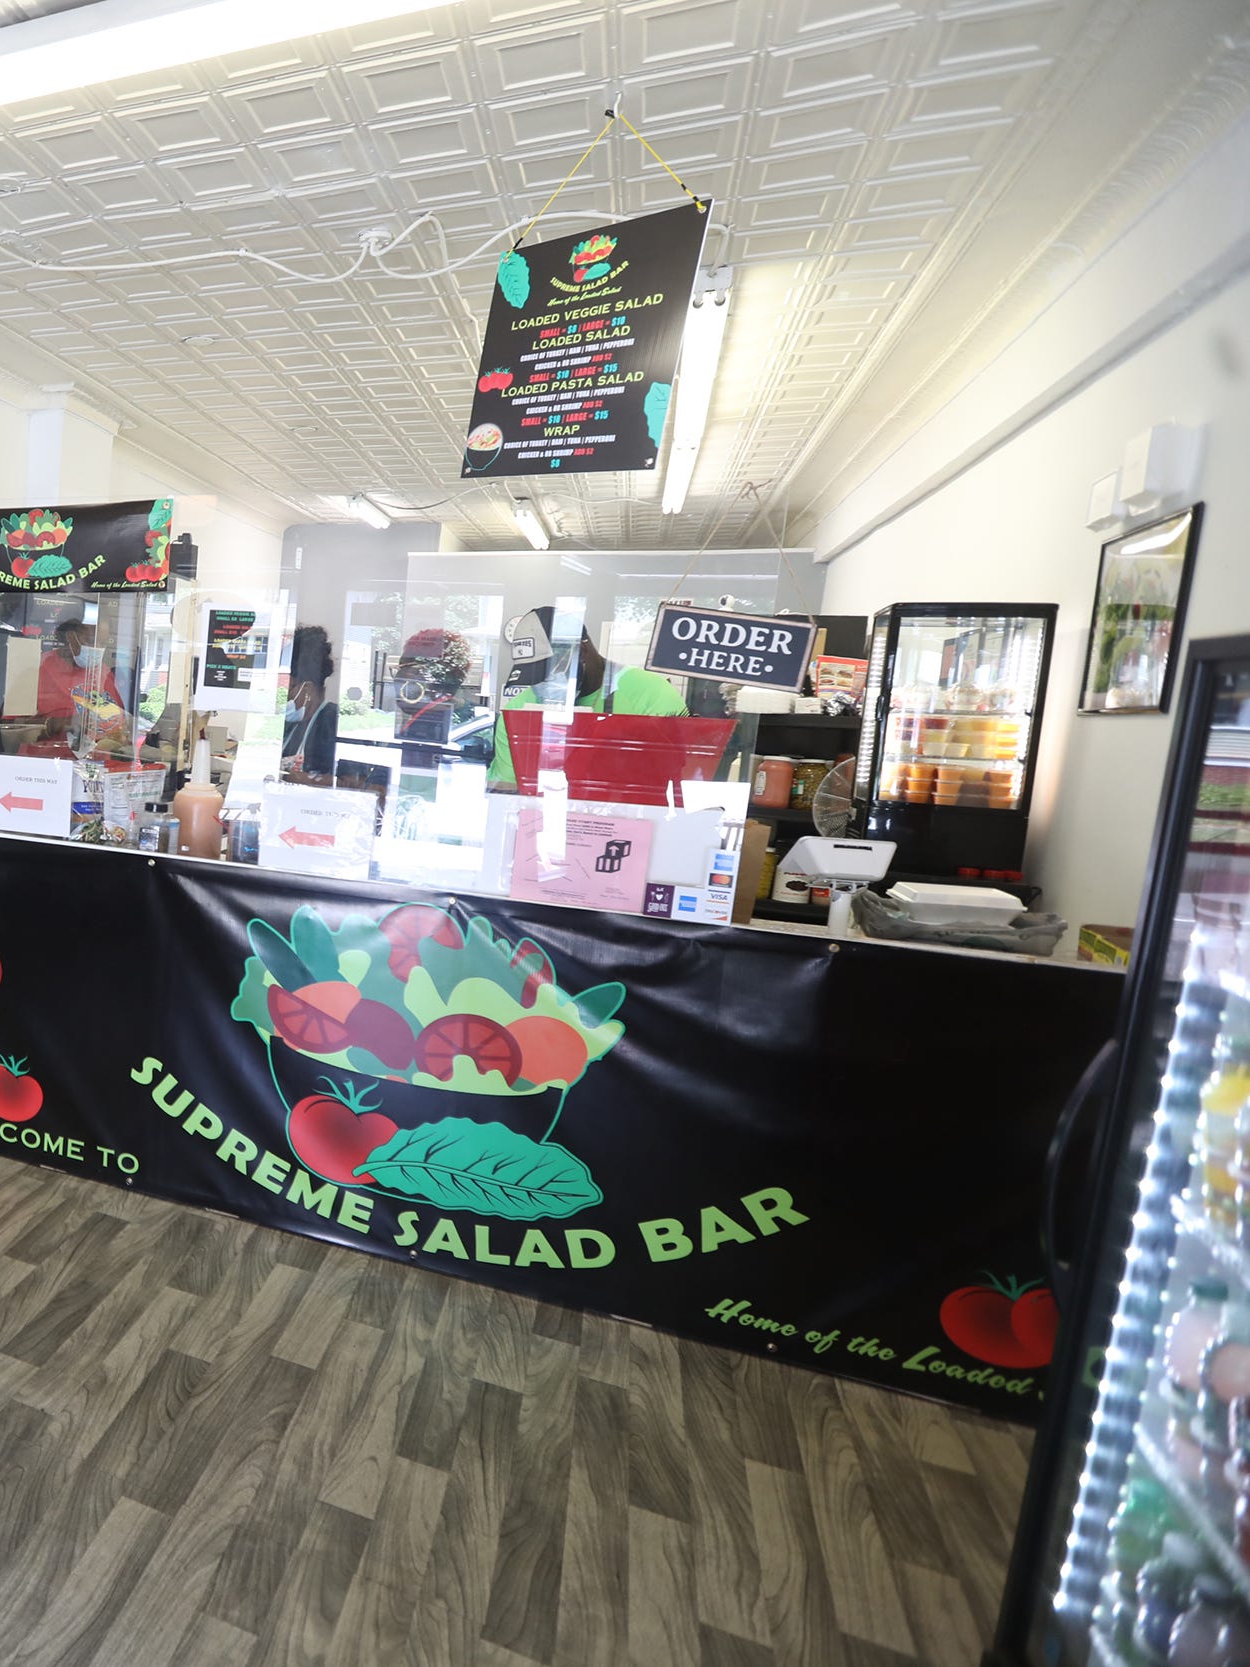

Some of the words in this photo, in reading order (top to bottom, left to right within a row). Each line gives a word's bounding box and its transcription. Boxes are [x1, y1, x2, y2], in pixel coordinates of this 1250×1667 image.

[550, 277, 580, 292] SUPREME
[581, 276, 608, 292] SALAD
[610, 260, 629, 279] BAR
[511, 314, 560, 330] LOADED
[564, 303, 611, 321] VEGGIE
[614, 294, 664, 311] SALAD
[532, 334, 582, 350] LOADED
[586, 326, 630, 341] SALAD
[540, 328, 560, 338] SMALL
[582, 320, 604, 332] LARGE
[501, 384, 548, 398] LOADED
[551, 378, 592, 391] PASTA
[598, 371, 644, 386] SALAD
[529, 373, 550, 382] SMALL
[574, 366, 596, 377] LARGE
[604, 363, 618, 374] $15
[521, 417, 541, 426] SMALL
[566, 412, 588, 422] LARGE
[594, 410, 608, 420] $15
[544, 425, 580, 437] WRAP
[34, 574, 76, 590] SALAD
[78, 554, 106, 578] BAR
[672, 617, 793, 655] ORDER
[687, 648, 765, 676] HERE
[97, 1146, 140, 1174] TO
[129, 1056, 374, 1234] SUPREME
[392, 1210, 617, 1270] SALAD
[637, 1186, 810, 1264] BAR
[704, 1298, 798, 1337] Home
[804, 1329, 841, 1355] of
[846, 1334, 898, 1362] the
[902, 1346, 1033, 1396] Loaded
